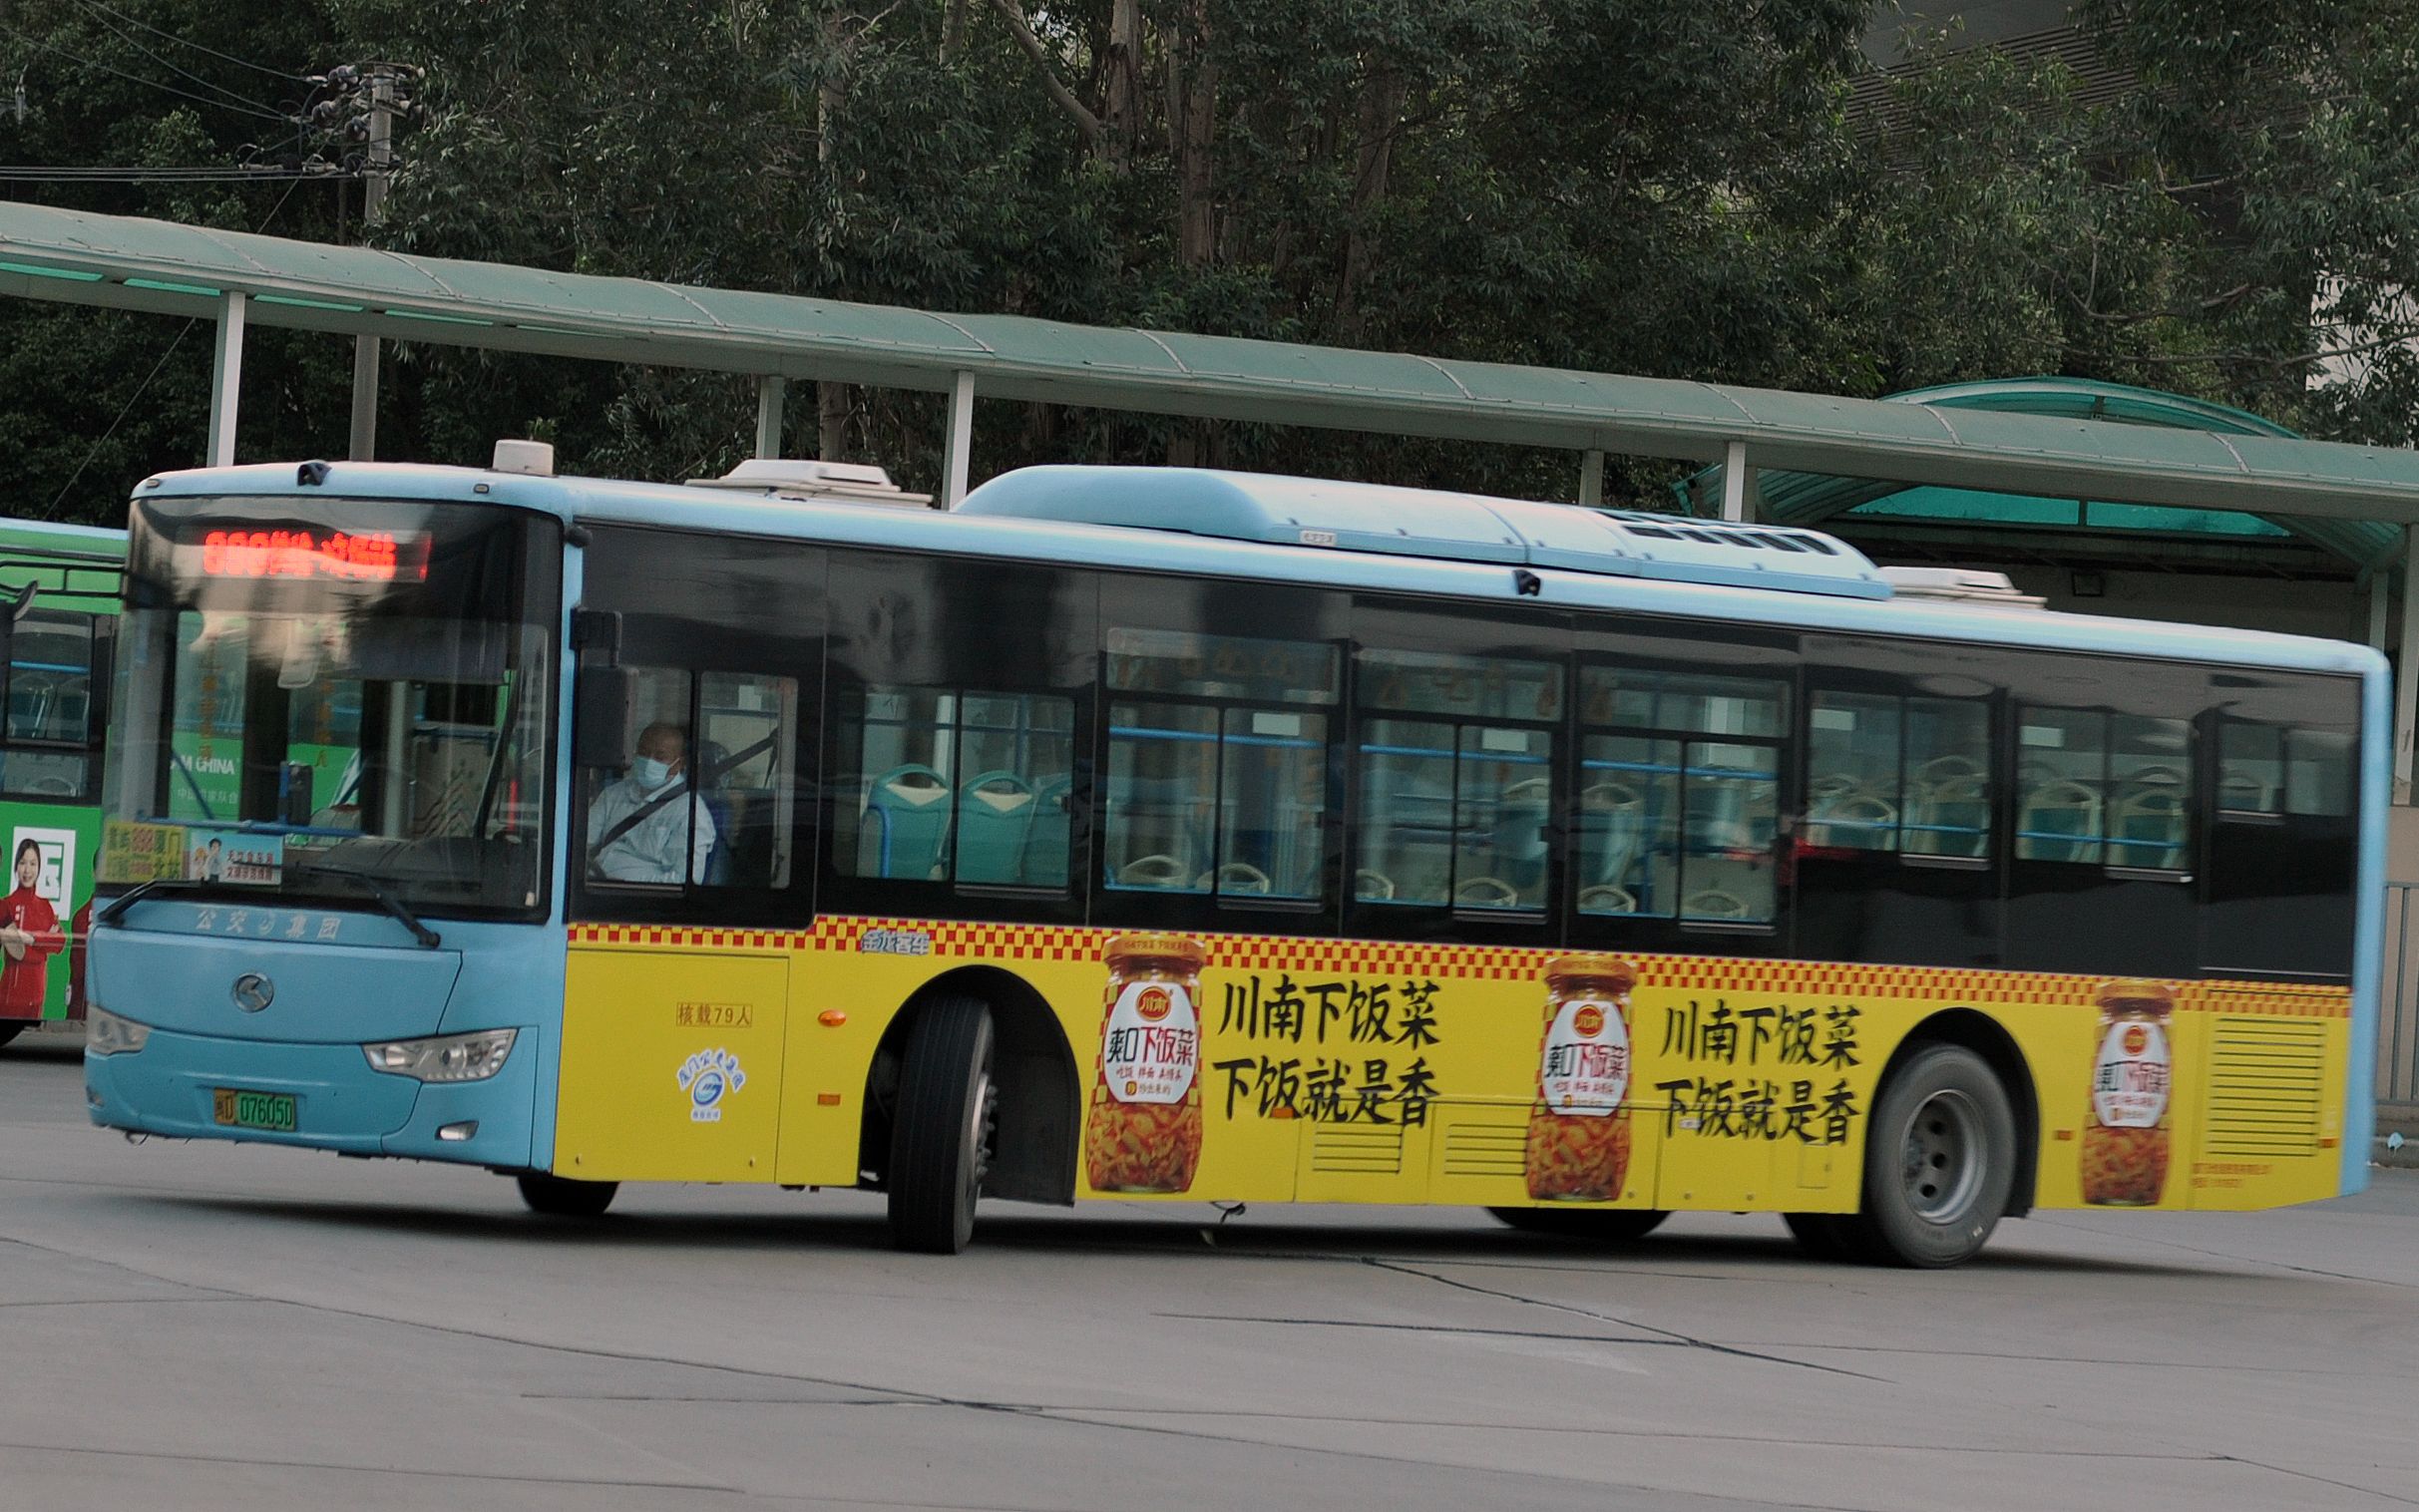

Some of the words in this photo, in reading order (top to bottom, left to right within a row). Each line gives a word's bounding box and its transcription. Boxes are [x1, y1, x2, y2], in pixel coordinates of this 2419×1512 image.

[196, 757, 235, 775] CHINA
[861, 930, 930, 955] 金龙客车
[677, 1003, 750, 1025] 核载79人
[1218, 973, 1441, 1050] 川南下饭菜
[1660, 998, 1861, 1071] 川南下饭菜
[1106, 1026, 1194, 1066] 爽口下饭菜
[1213, 1054, 1441, 1129] 下饭就是香
[1655, 1076, 1861, 1147] 下饭就是香
